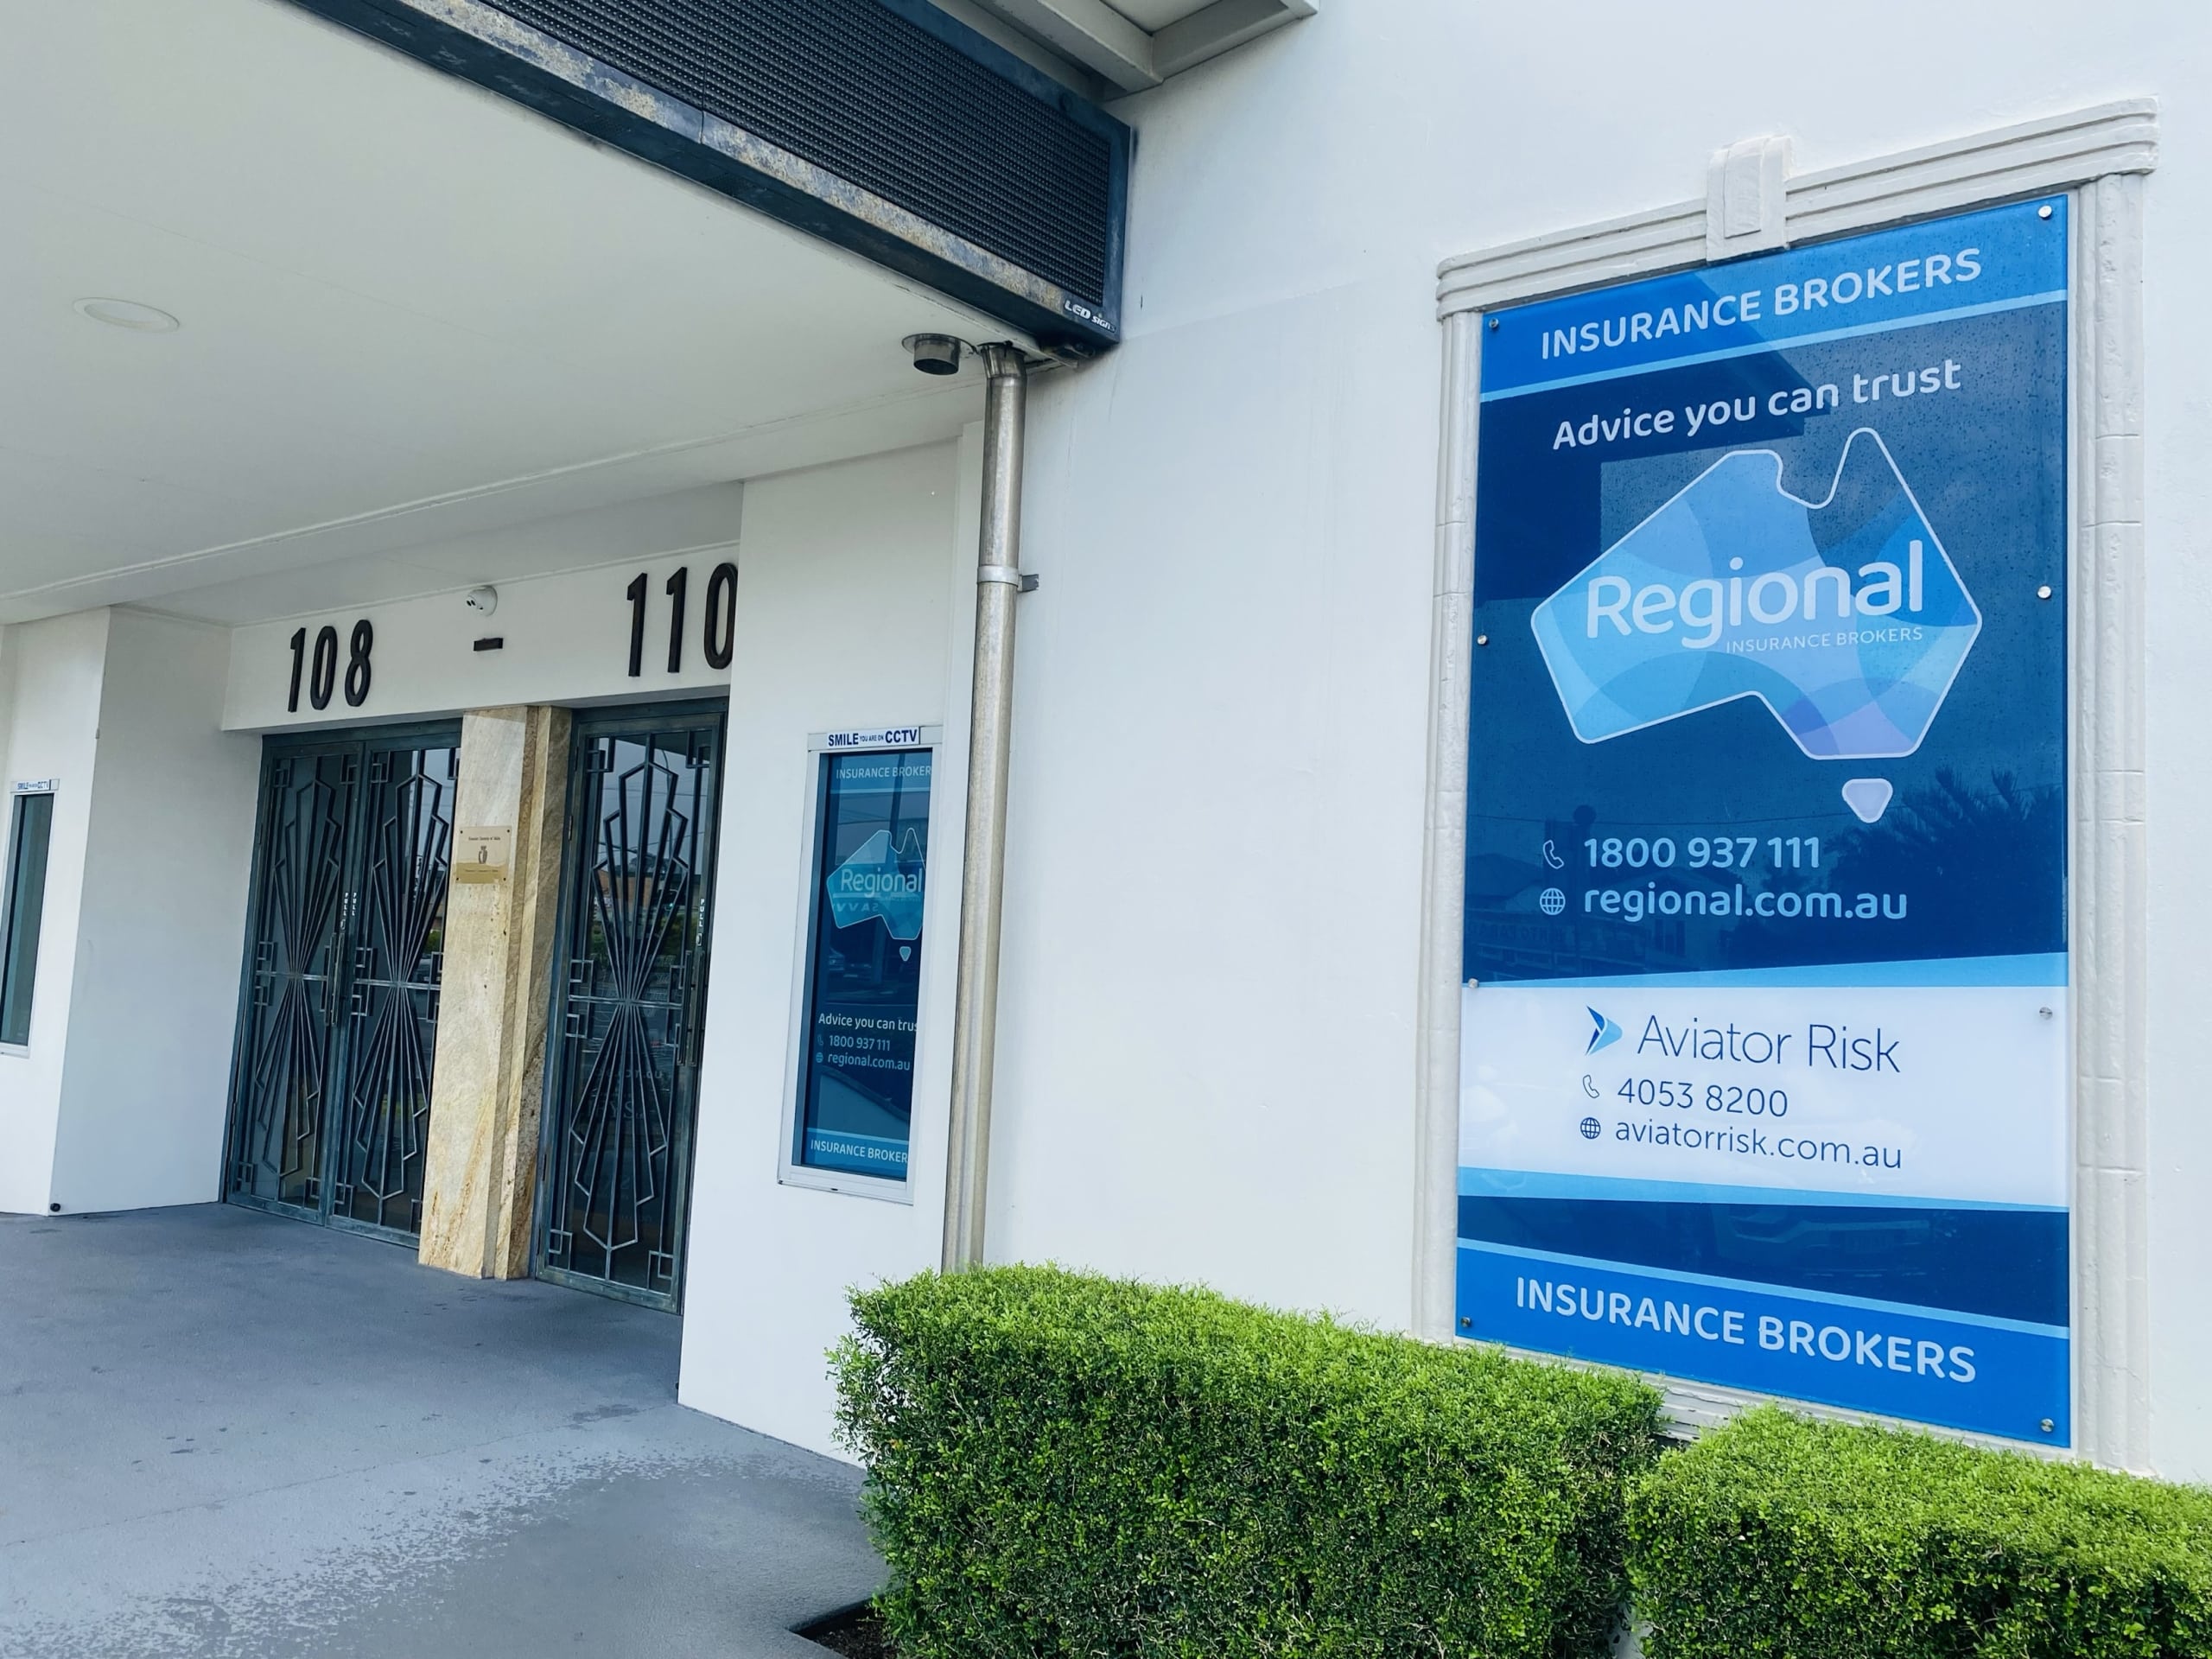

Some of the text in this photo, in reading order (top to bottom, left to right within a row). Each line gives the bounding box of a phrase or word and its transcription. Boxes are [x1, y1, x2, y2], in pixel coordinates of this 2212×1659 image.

[1065, 300, 1090, 319] LED
[1541, 247, 1983, 360] INSURANCE BROKERS
[1552, 359, 1961, 450] Advice you can trust
[1586, 539, 1924, 650] Regional
[287, 619, 373, 713] 108
[626, 562, 739, 678] 110
[1726, 626, 1923, 653] INSURANCE BROKERS
[828, 733, 859, 747] SMILE
[885, 728, 918, 744] CCTV
[836, 766, 890, 779] INSURANCE
[1584, 836, 1821, 869] 1800 937 111
[840, 867, 924, 899] Regional
[1584, 882, 1908, 923] regional.com.au
[818, 1013, 853, 1027] Advice
[855, 1017, 874, 1030] you
[876, 1020, 896, 1031] can
[829, 1034, 891, 1052] 1800 937 111
[1637, 1014, 1902, 1074] Aviator Risk
[828, 1052, 911, 1071] regional.com.au
[1617, 1077, 1789, 1118] 4053 8200
[810, 1139, 865, 1157] INSURANCE
[1615, 1118, 1903, 1170] aviatorrisk.com.au
[1516, 1275, 1977, 1384] INSURANCE BROKERS
